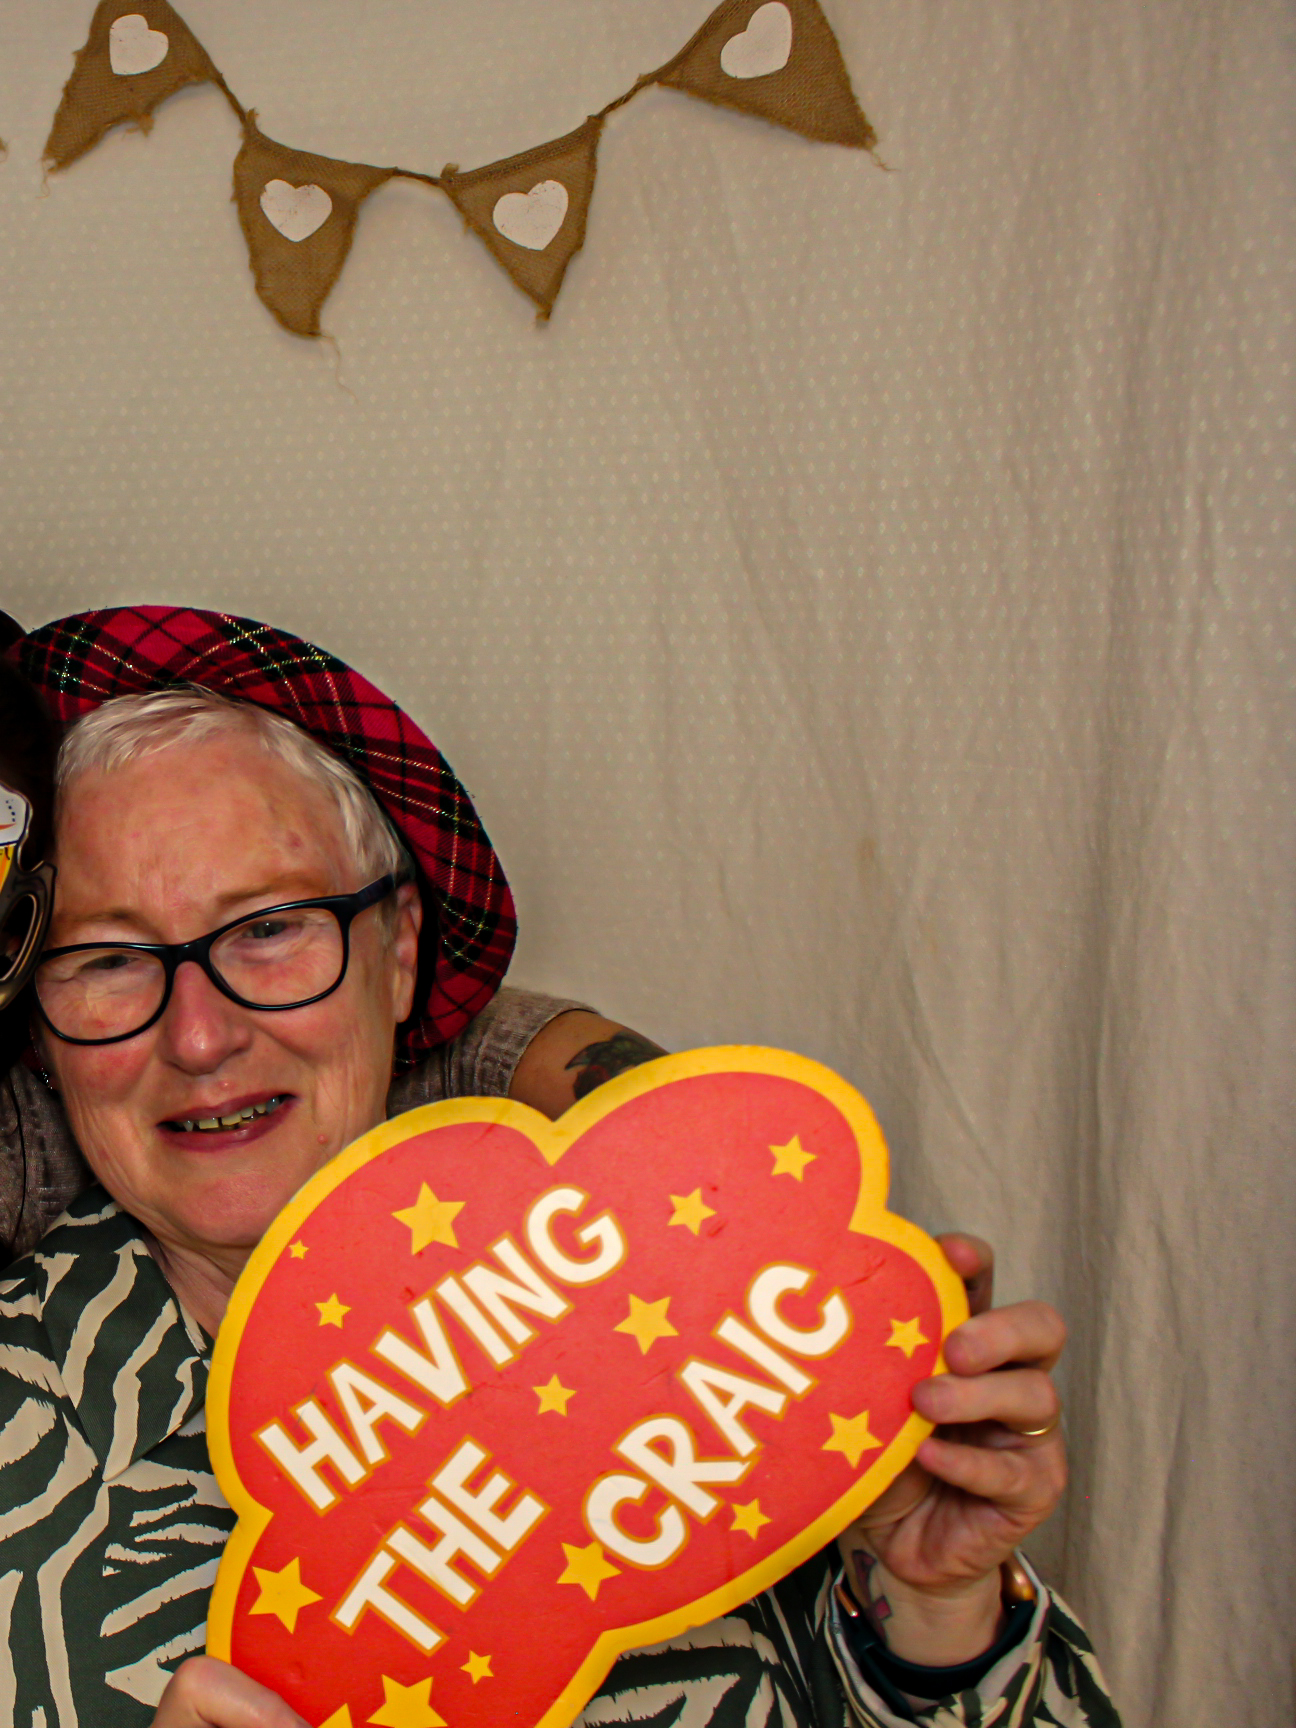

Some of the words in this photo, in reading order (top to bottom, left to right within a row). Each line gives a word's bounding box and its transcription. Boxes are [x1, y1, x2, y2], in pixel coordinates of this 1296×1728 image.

[255, 1186, 626, 1513] HAVING
[583, 1262, 851, 1569] CRAIC
[331, 1436, 549, 1654] THE
